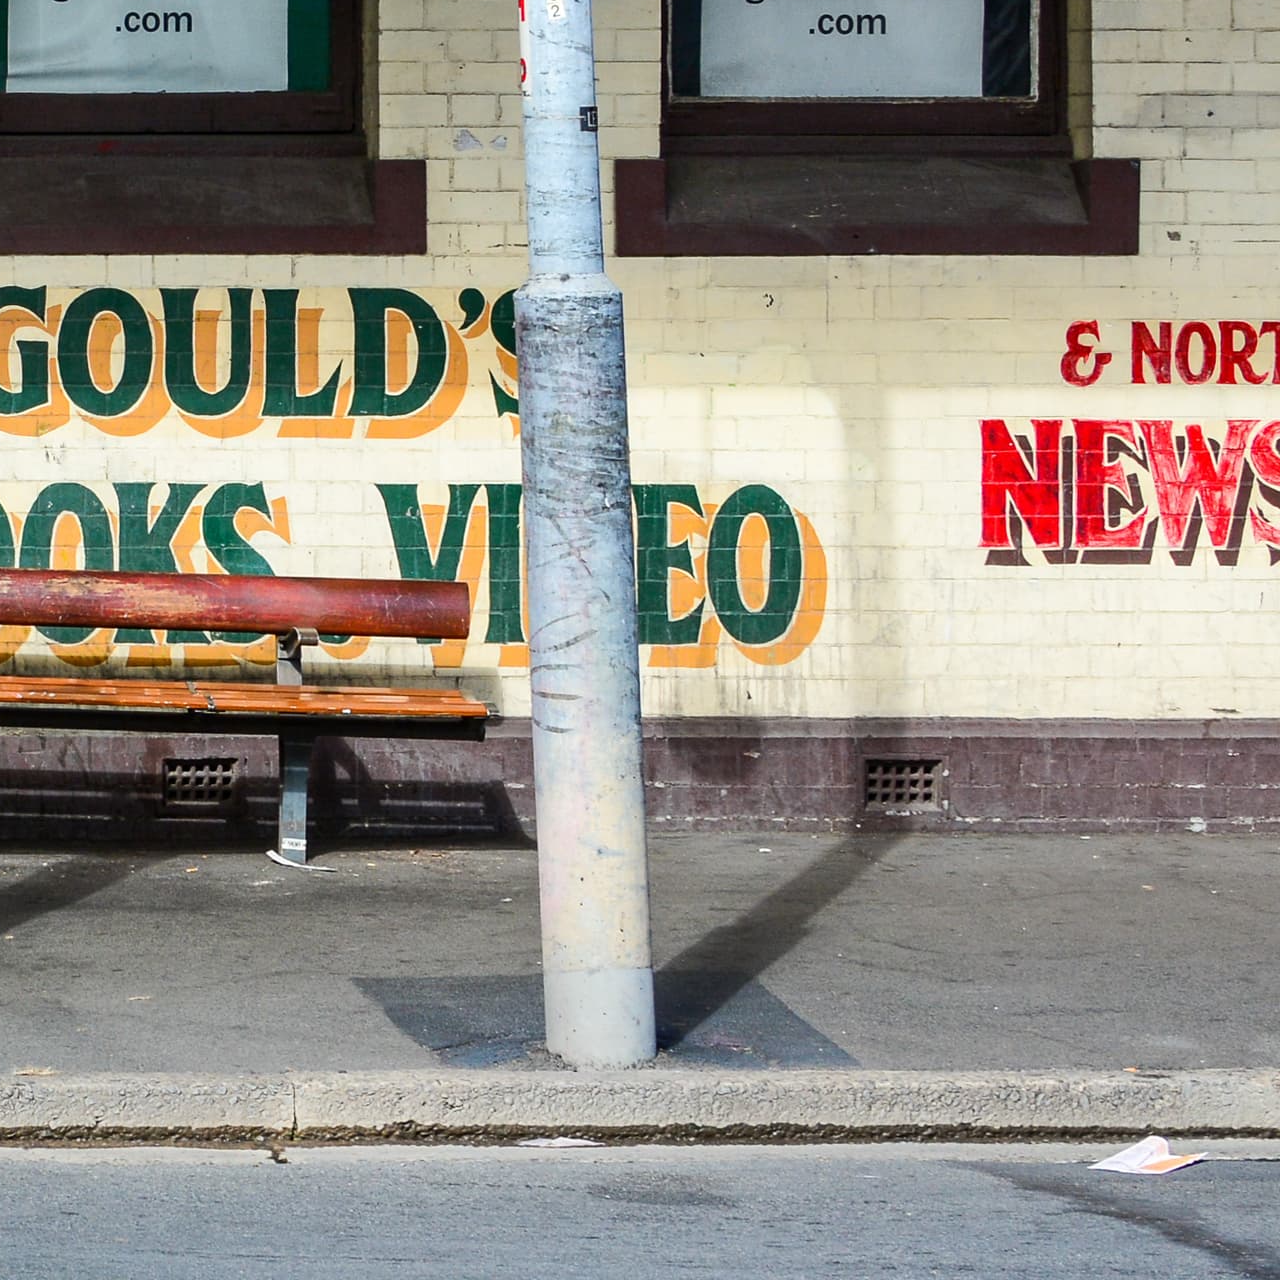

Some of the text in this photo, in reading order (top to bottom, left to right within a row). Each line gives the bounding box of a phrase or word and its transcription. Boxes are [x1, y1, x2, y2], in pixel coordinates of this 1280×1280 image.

[115, 11, 193, 33] .com
[808, 13, 887, 36] .com
[1060, 320, 1113, 387] &
[374, 483, 810, 646] VIEO
